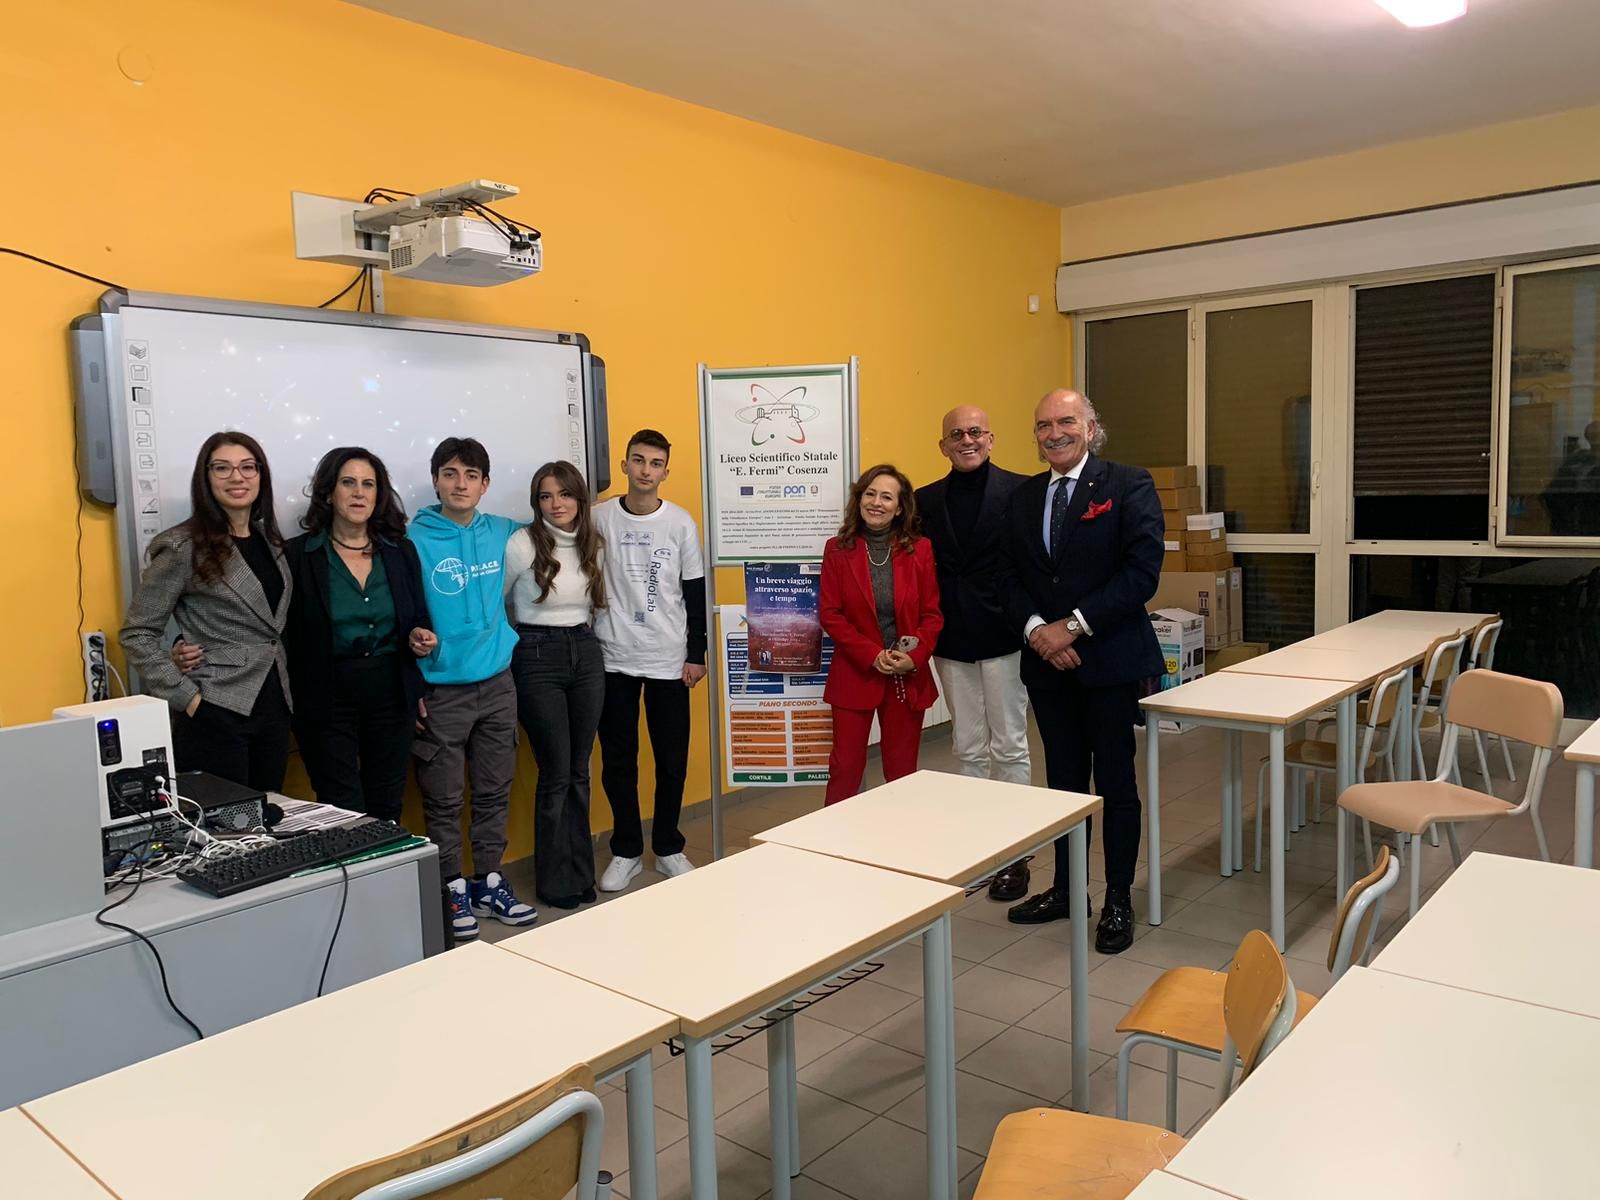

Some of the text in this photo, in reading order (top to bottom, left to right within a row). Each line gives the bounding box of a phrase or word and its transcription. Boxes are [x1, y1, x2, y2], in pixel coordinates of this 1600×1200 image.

[720, 451, 838, 463] Liceo Scientifico Statale
[749, 465, 784, 476] Fermi”
[787, 465, 828, 475] Cosenza
[783, 485, 806, 498] pon
[647, 561, 661, 612] RadioLab
[787, 577, 812, 586] viaggio
[790, 586, 813, 594] spazio
[775, 595, 797, 603] tempo
